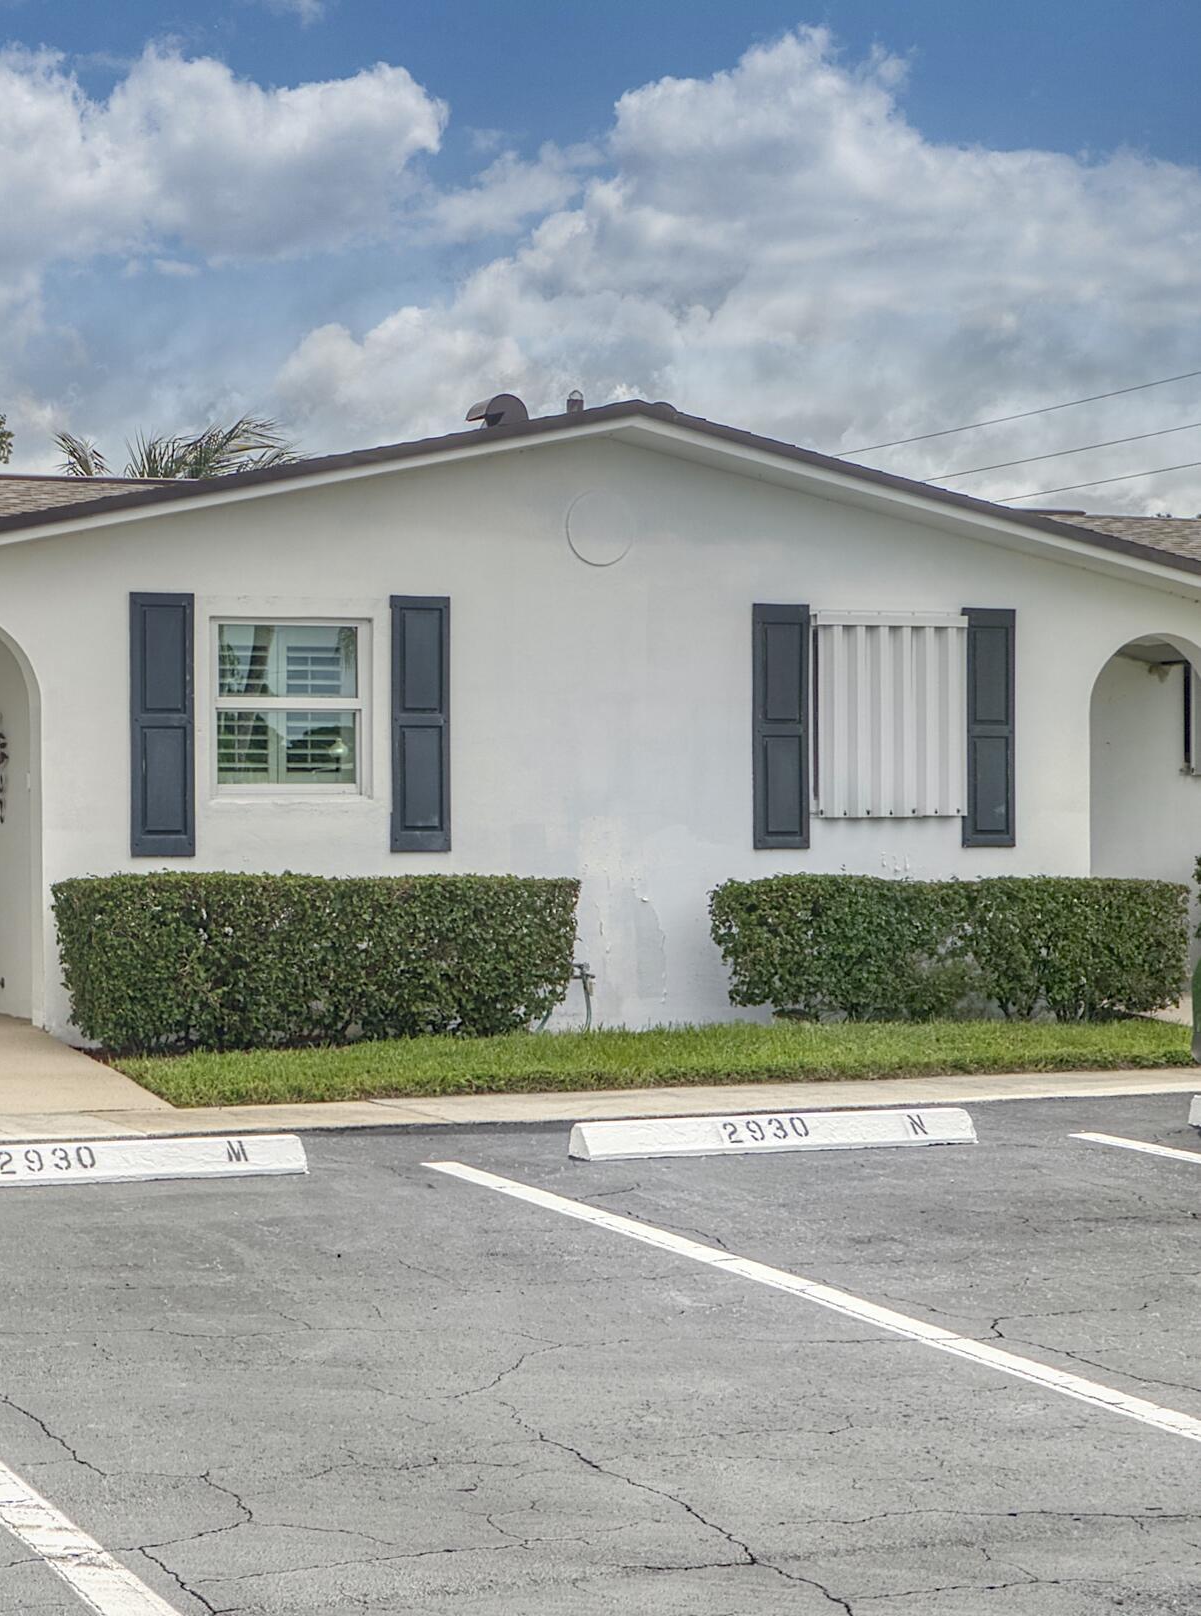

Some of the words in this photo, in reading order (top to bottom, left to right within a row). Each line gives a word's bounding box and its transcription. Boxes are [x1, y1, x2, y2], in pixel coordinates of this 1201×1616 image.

[722, 1117, 809, 1143] 2930
[906, 1114, 928, 1135] N
[226, 1140, 248, 1162] M
